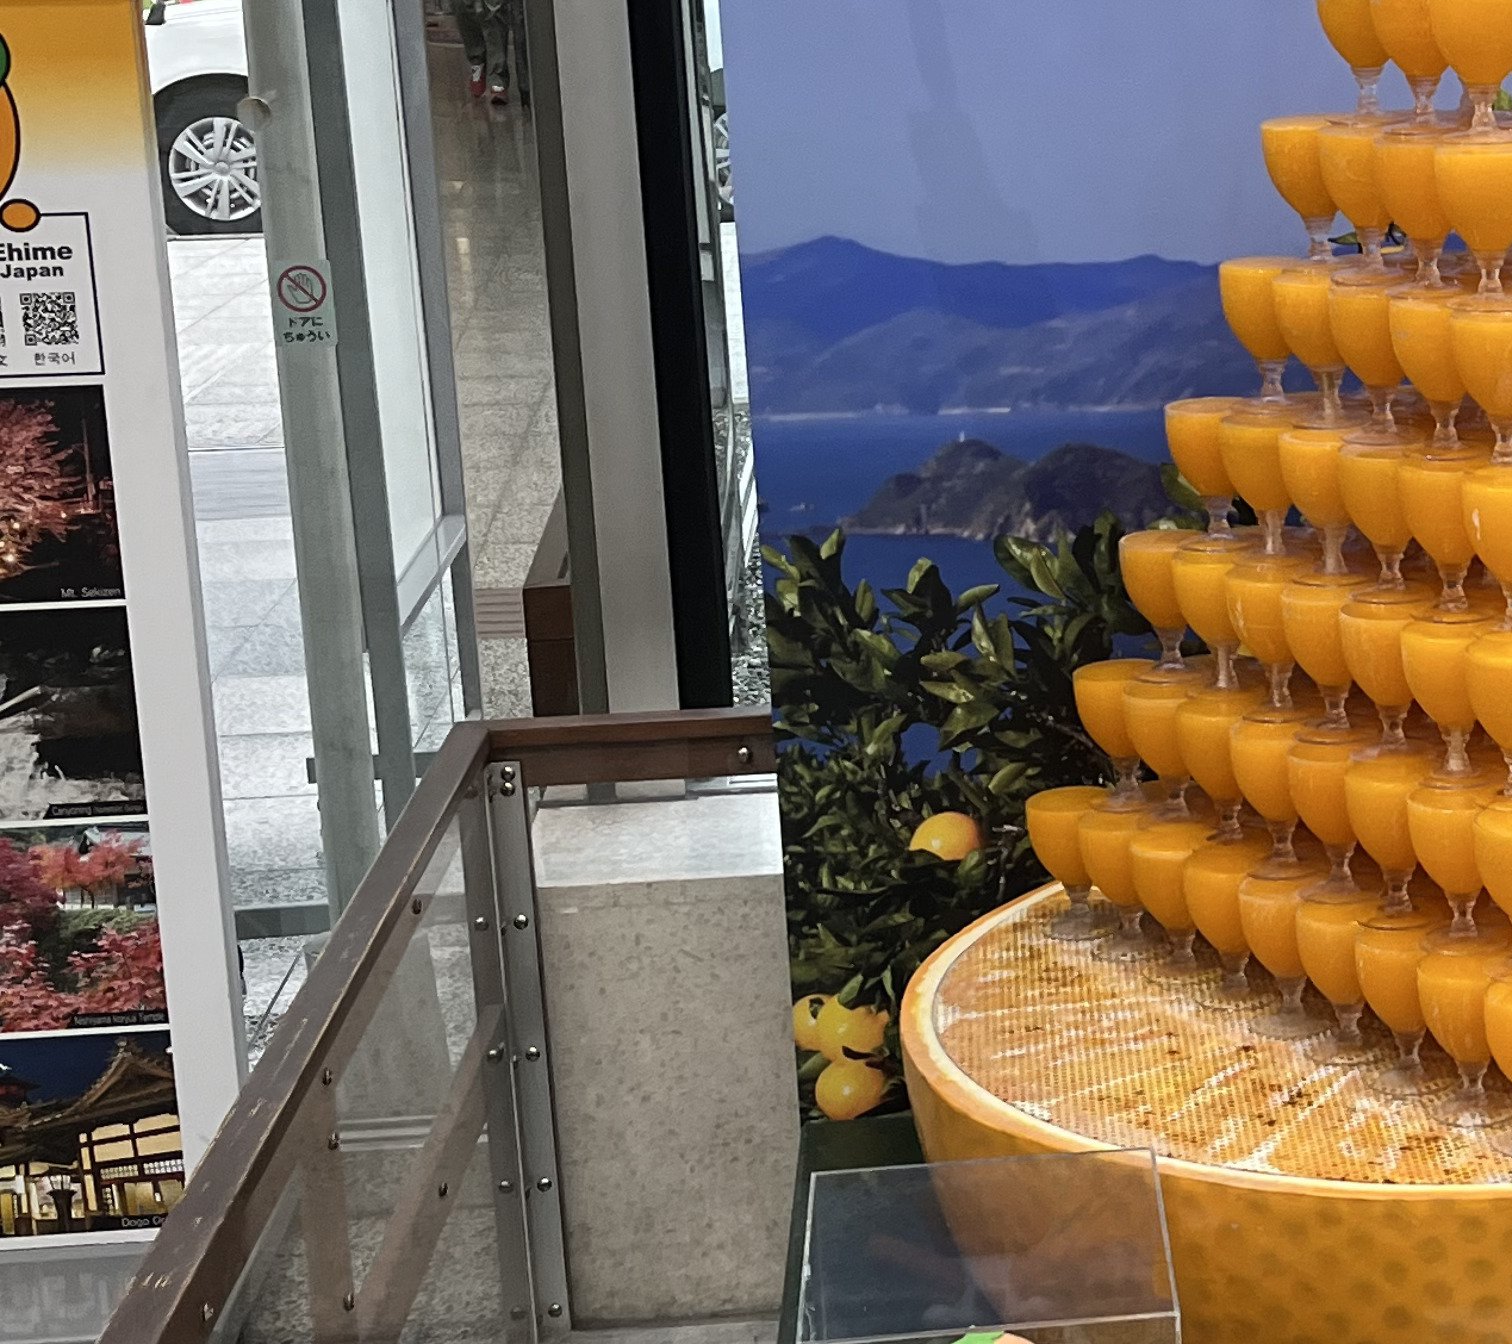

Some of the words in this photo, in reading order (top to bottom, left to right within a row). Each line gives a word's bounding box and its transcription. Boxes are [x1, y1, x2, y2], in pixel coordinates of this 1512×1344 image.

[0, 264, 64, 281] Japan
[289, 316, 324, 328] ドアに
